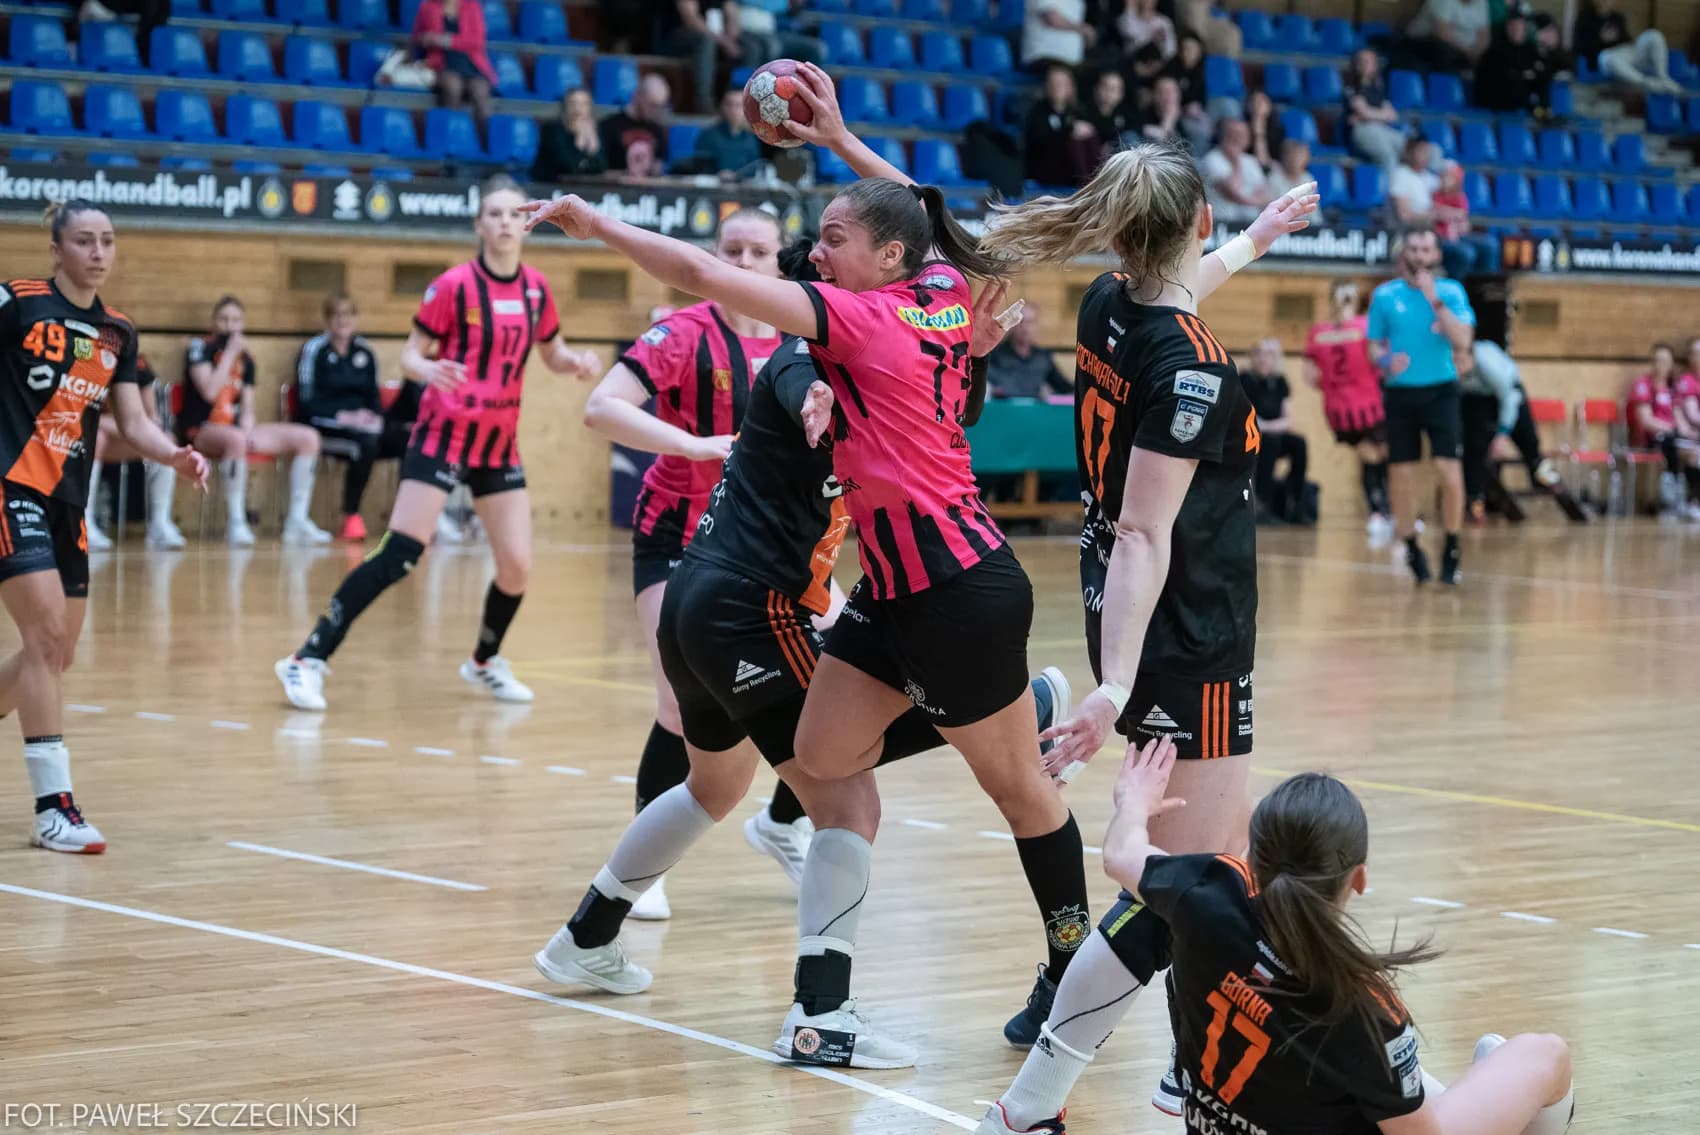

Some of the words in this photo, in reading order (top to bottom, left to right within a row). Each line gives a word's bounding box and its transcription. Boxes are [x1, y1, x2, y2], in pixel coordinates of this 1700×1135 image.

[0, 165, 251, 218] koronahandball.pl
[22, 320, 67, 362] 49
[502, 325, 522, 356] 17
[1179, 381, 1216, 398] RTBS
[1220, 971, 1273, 1027] GÓRNA
[1201, 990, 1272, 1105] 17
